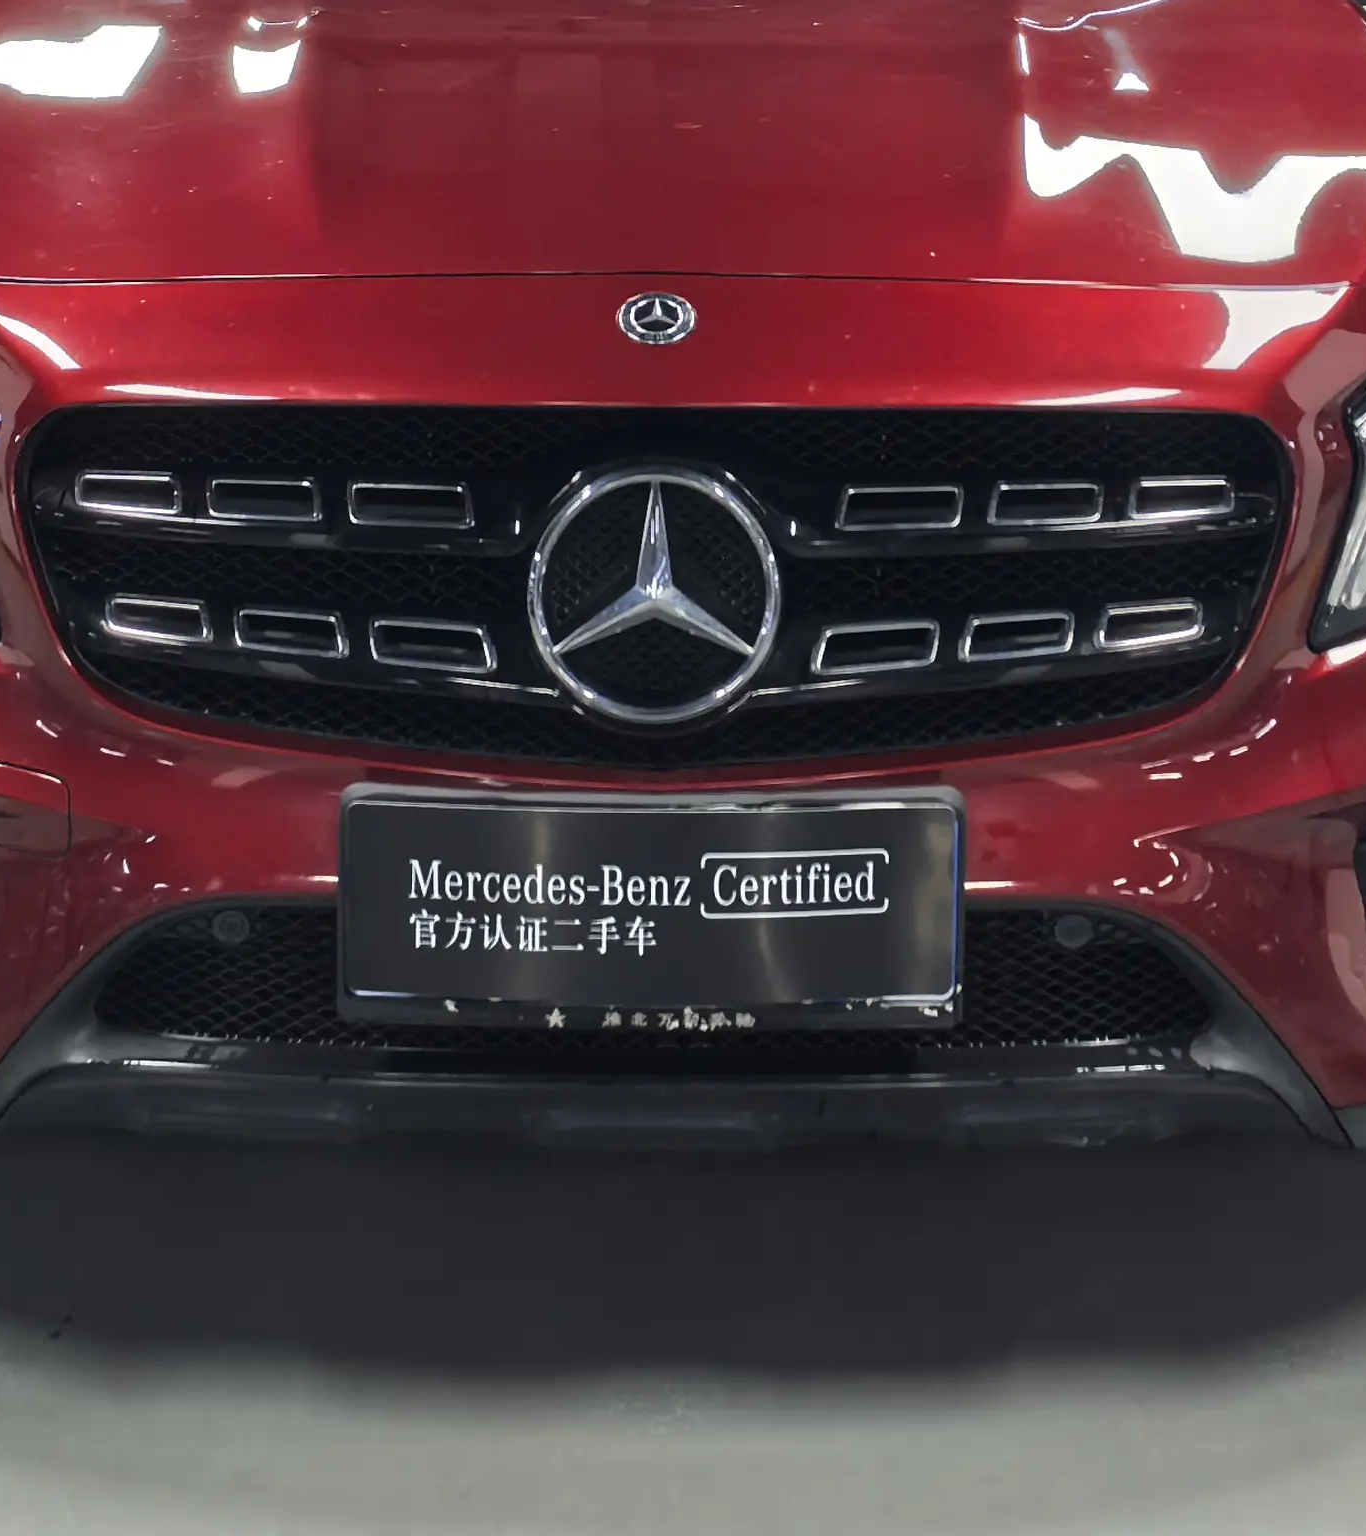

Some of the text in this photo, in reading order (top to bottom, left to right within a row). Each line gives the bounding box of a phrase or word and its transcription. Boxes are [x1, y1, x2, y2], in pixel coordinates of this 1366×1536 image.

[408, 858, 875, 906] Mercedes-Benz Certified
[409, 908, 657, 956] 官方认证二手车
